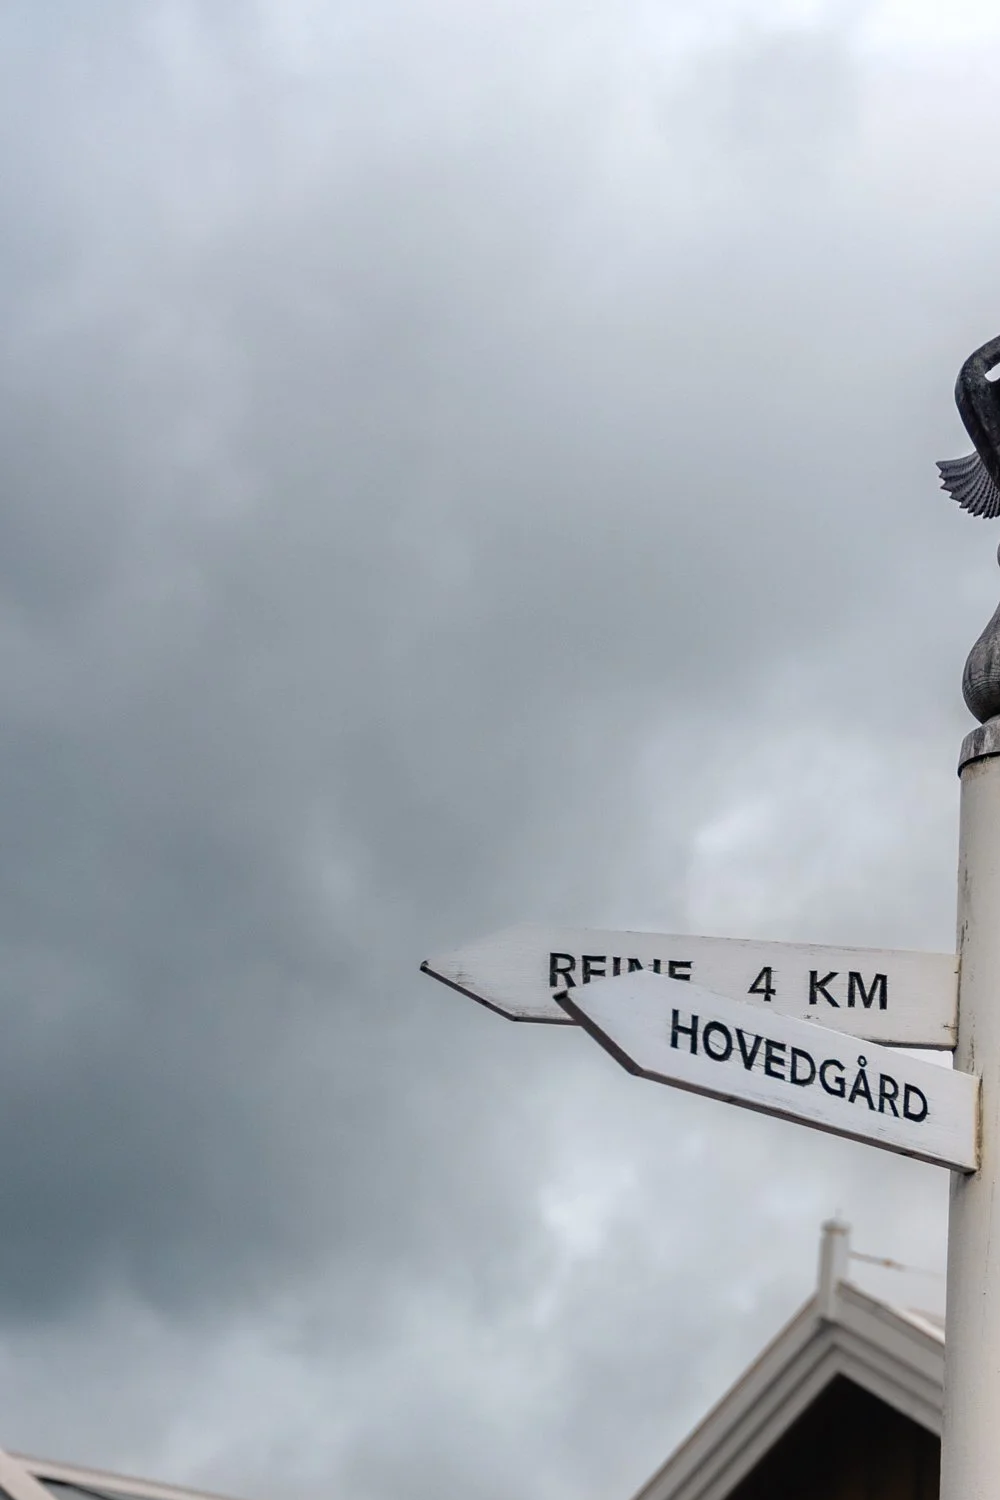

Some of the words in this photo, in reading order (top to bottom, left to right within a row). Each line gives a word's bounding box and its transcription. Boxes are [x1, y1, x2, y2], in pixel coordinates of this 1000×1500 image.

[748, 966, 777, 1002] 4
[808, 970, 889, 1010] KM
[669, 1008, 930, 1124] HOVEDGÅRD
